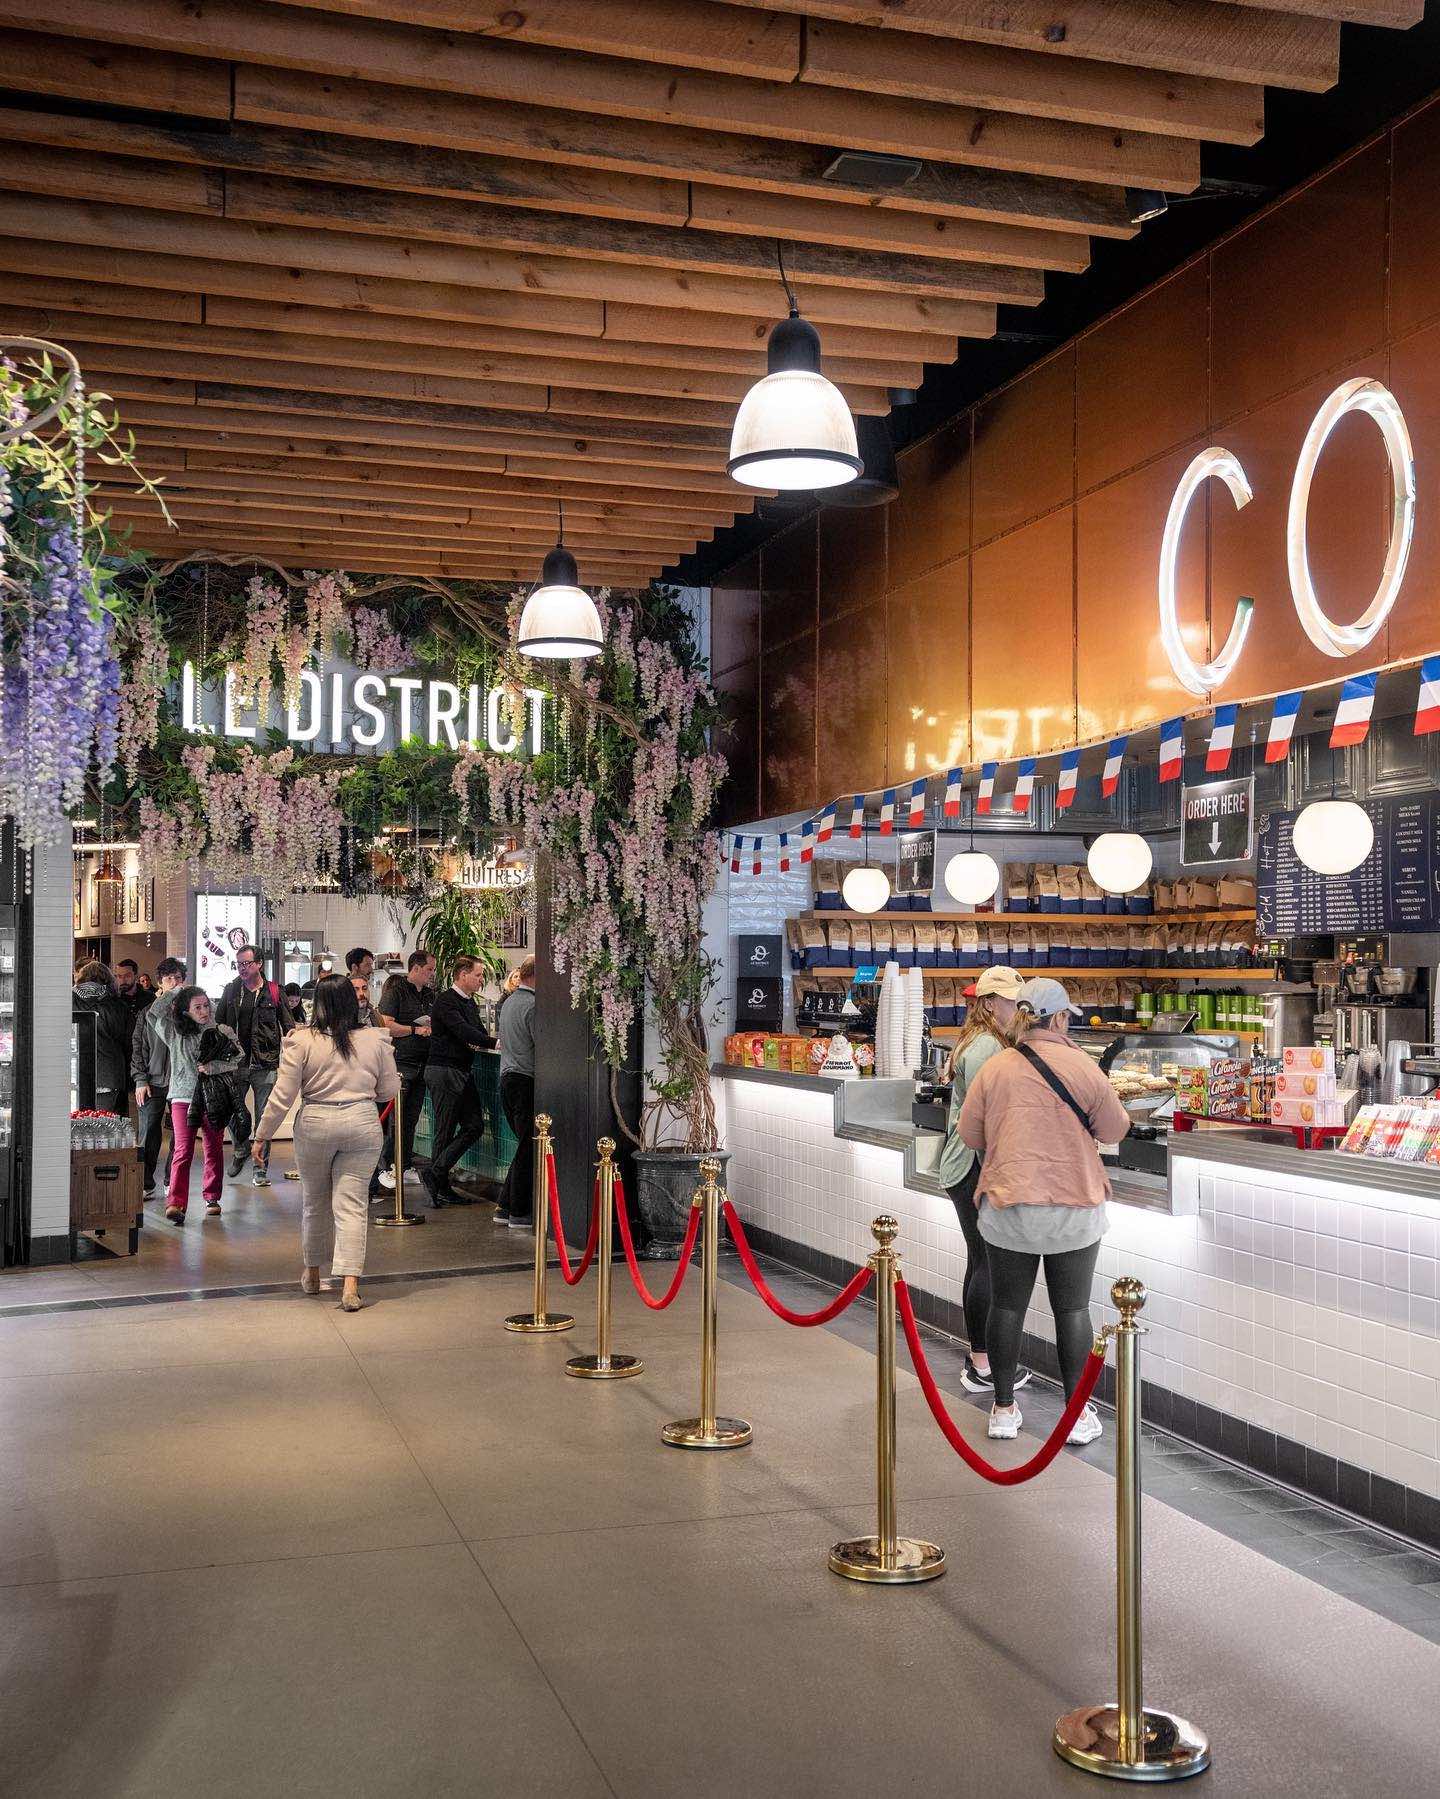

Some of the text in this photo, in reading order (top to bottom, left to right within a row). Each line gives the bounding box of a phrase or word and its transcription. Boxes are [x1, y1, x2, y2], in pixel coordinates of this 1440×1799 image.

[182, 660, 548, 755] LE DISTRICT
[1187, 792, 1245, 819] ORDER HERE
[901, 841, 932, 859] ORDER HERE
[1213, 1060, 1241, 1076] Granola
[1210, 1080, 1237, 1096] Granola
[1211, 1100, 1238, 1115] Granola
